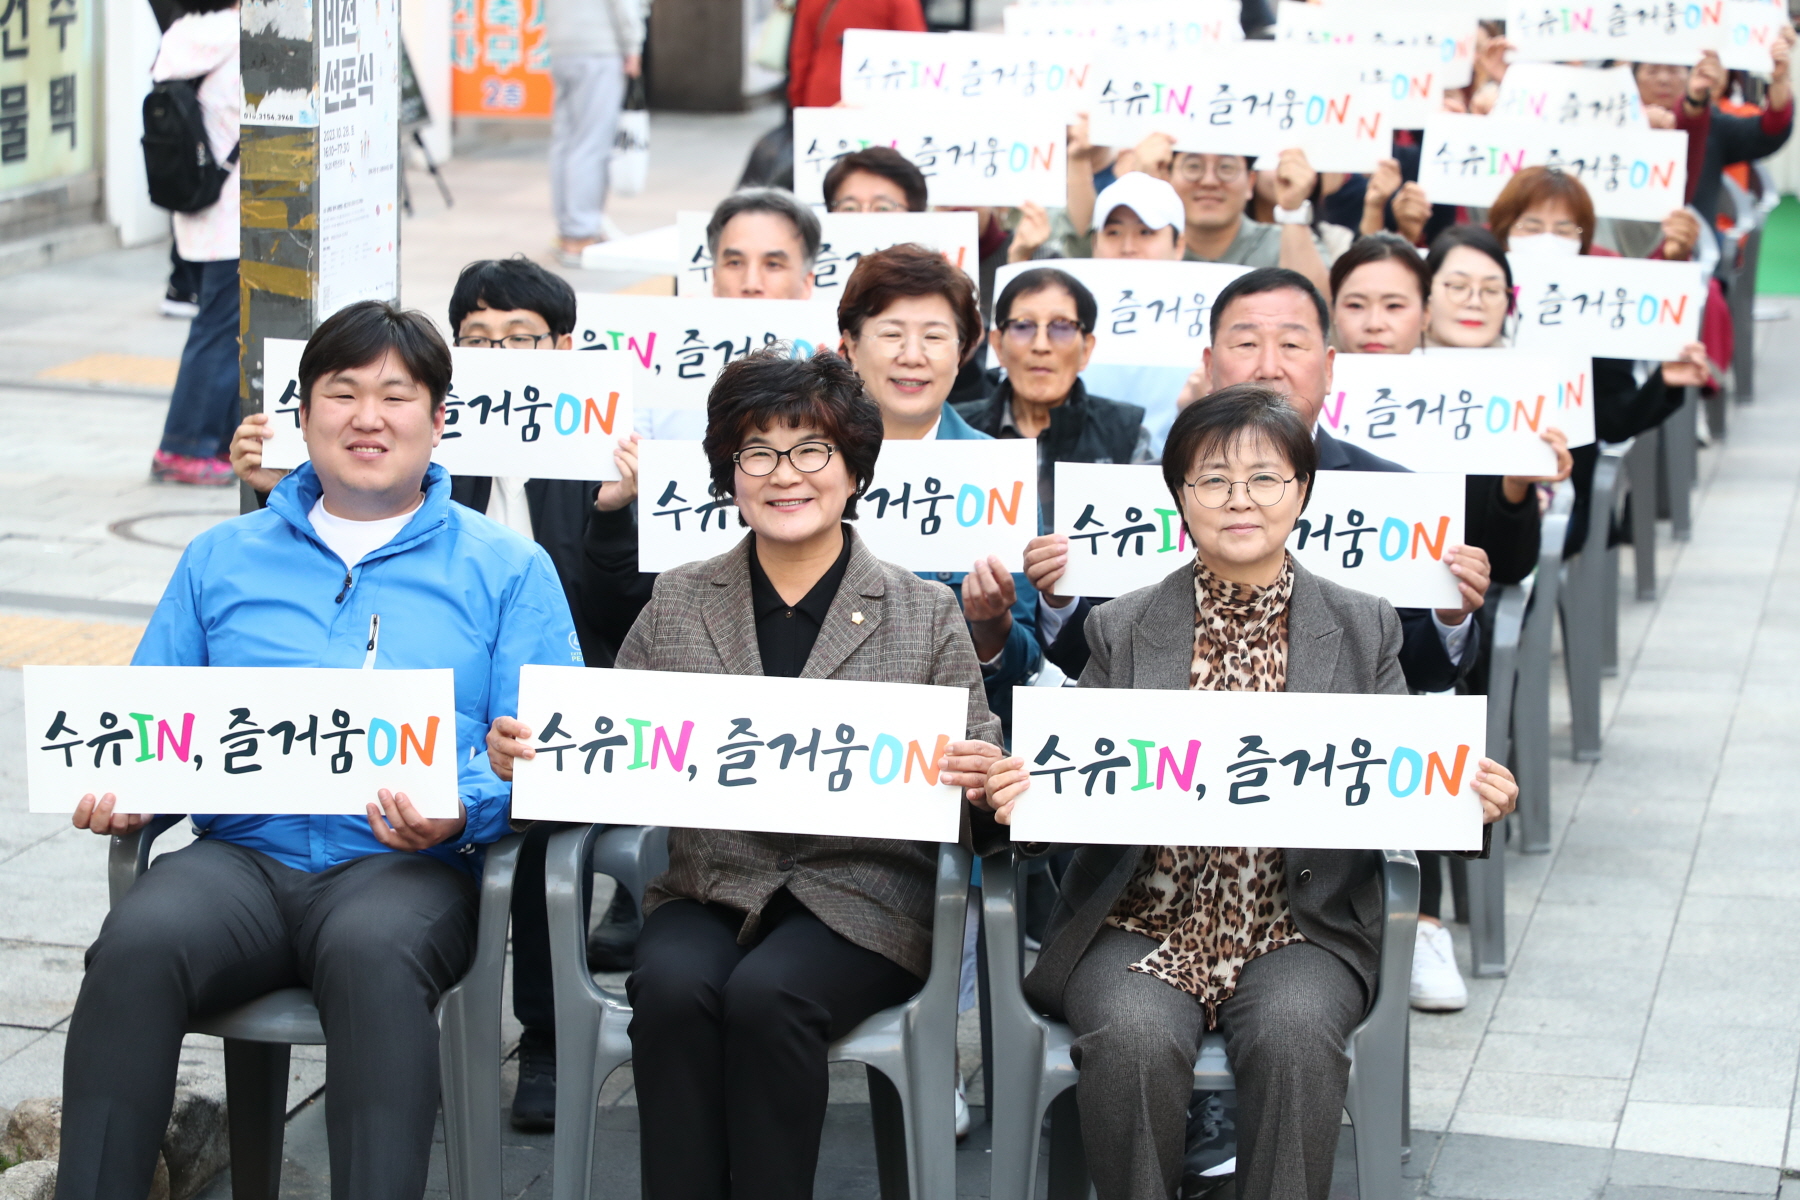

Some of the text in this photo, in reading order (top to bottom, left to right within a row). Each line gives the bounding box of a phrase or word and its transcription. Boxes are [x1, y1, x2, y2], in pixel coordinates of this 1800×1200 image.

[324, 52, 374, 114] 선포식
[961, 60, 1090, 97] 즐거움ON
[1208, 83, 1351, 130] 즐거움ON
[915, 137, 1055, 177] 즐거움ON
[1111, 289, 1212, 338] 즐거움
[1538, 284, 1688, 329] 즐거움ON
[1366, 388, 1546, 440] 즐거움ON
[863, 476, 1024, 536] 거움ON
[1296, 508, 1451, 569] 거움ON
[40, 707, 441, 775] 수유IN, 즐거움ON
[535, 711, 951, 792] 수유IN, 즐거움ON
[1029, 734, 1471, 806] 수유IN, 즐거움ON
